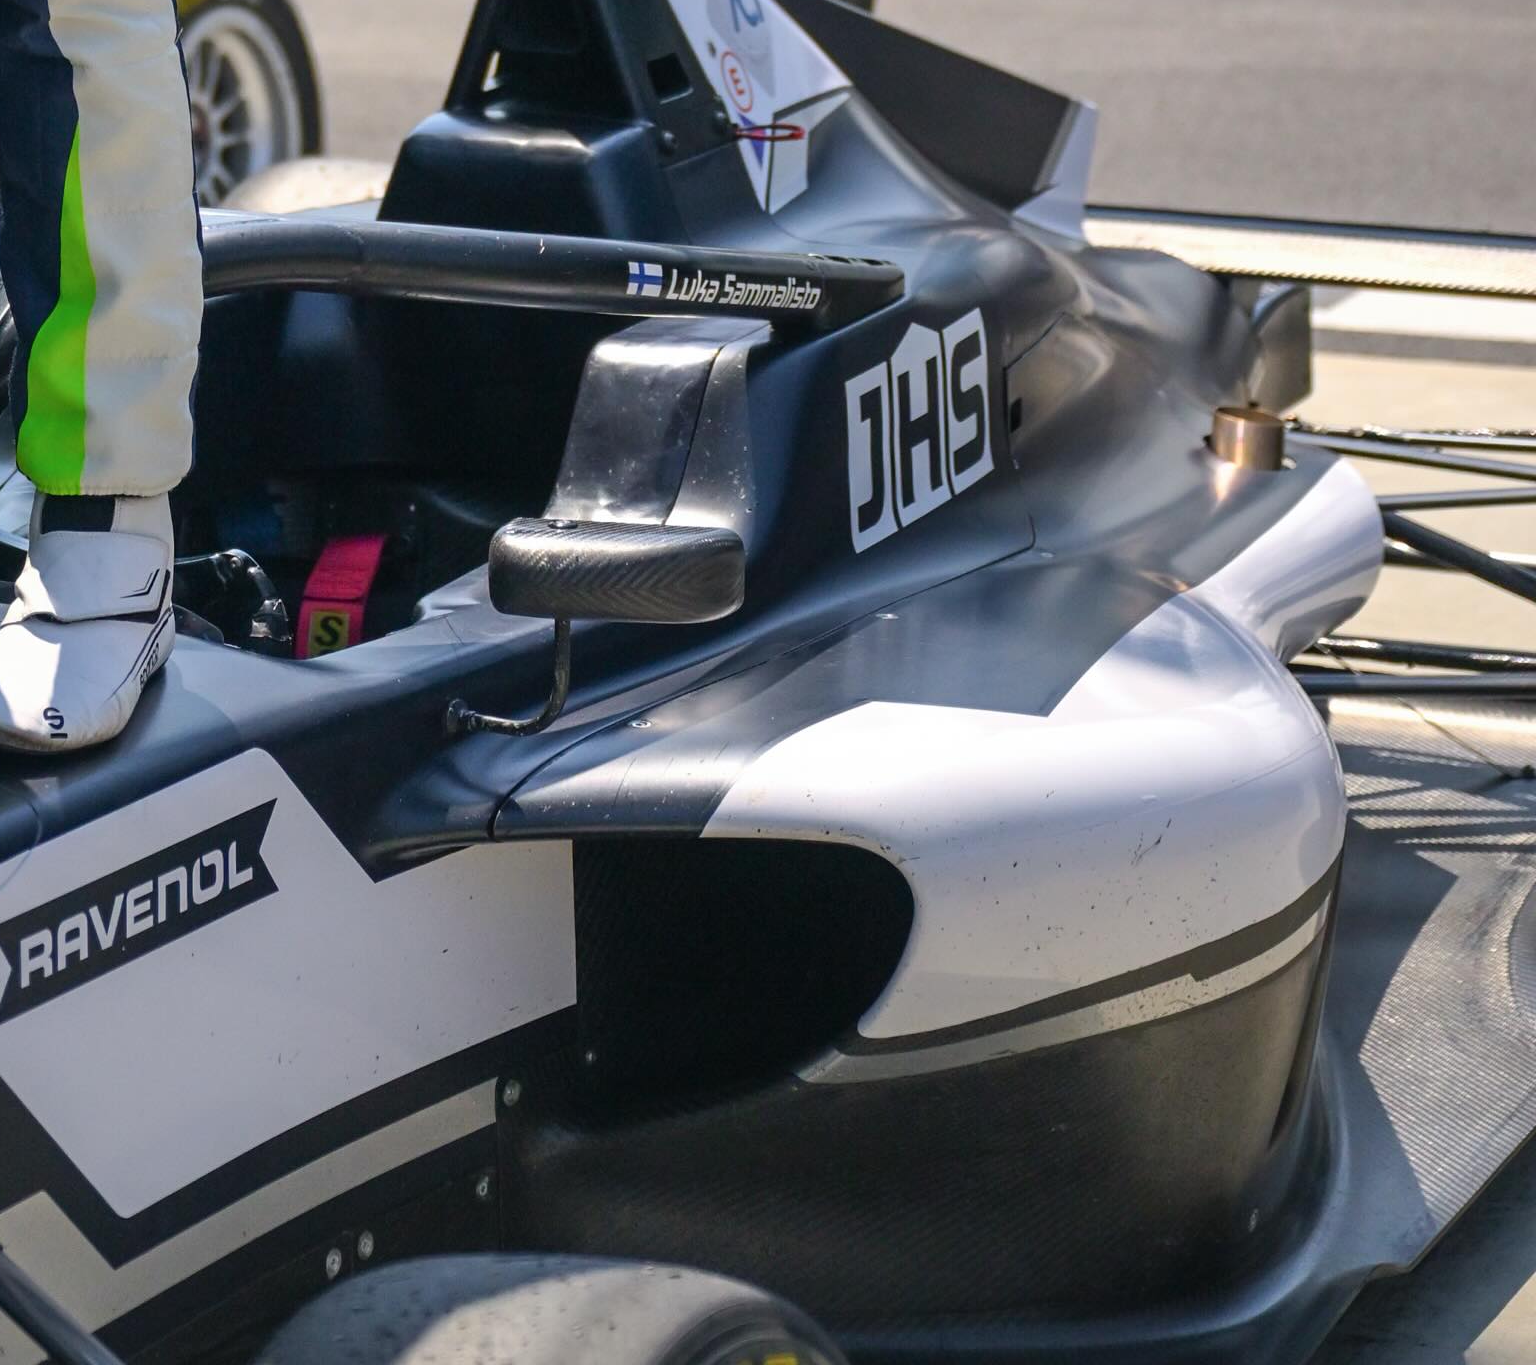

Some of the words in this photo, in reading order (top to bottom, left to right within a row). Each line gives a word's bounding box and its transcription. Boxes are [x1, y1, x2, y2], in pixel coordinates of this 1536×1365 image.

[665, 268, 721, 304] Luka
[718, 273, 822, 310] Sammalisto
[857, 328, 988, 536] JHS
[18, 839, 254, 989] RAVENOL
